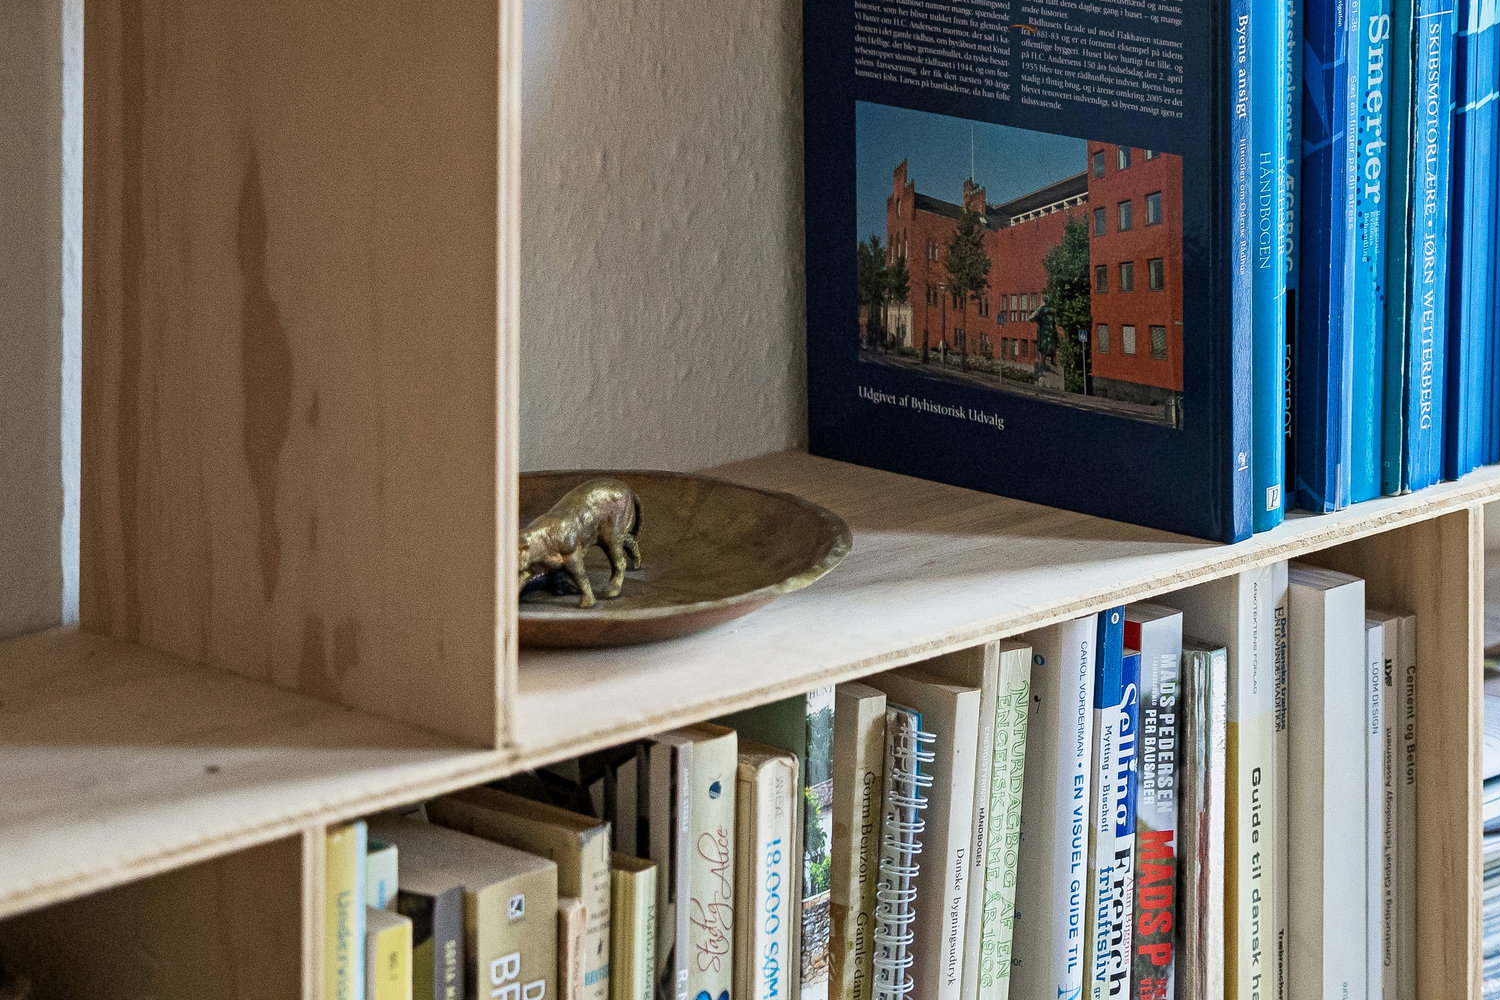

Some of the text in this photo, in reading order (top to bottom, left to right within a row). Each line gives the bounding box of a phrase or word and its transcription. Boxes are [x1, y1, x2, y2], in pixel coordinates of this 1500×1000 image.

[1236, 14, 1249, 63] Byens
[1350, 0, 1359, 32] 61.36
[1236, 68, 1248, 120] ansigt
[1349, 75, 1357, 99] Sæt
[1364, 13, 1390, 203] Smerter
[1346, 157, 1357, 172] på
[1347, 119, 1357, 154] finger
[1240, 184, 1245, 198] om
[1258, 152, 1275, 270] HÅNDBOGEN
[1348, 175, 1357, 190] dit
[1239, 240, 1247, 275] Rådhus
[1418, 22, 1440, 431] SKIBSMOTORLÆRE JØRN WETTERBERG
[858, 385, 1004, 430] Udgivet af Byhistorisk Udvalg
[1080, 640, 1089, 681] CAROL
[1076, 682, 1086, 757] VORDERMAN
[1371, 661, 1379, 735] LOOM DESIGN
[1404, 665, 1416, 785] Cement og Beton
[1143, 709, 1156, 805] PER BAUSAGER
[1157, 654, 1175, 813] MADS PEDERSEN
[1384, 727, 1392, 788] Assessment
[860, 770, 877, 819] Gorm
[1073, 774, 1084, 800] EN
[1100, 725, 1113, 833] Mytting Bischoff
[1251, 767, 1261, 844] Guide
[858, 822, 873, 884] Benzon
[979, 694, 1009, 989] ENGELSK DAME ÅR 1906
[995, 680, 1030, 979] NATURDAGBOG AF EN
[1070, 805, 1083, 874] VISUEL
[1109, 683, 1137, 998] Selling French
[1384, 790, 1393, 852] Technology
[690, 825, 734, 973] Stadig Alice
[765, 837, 782, 936] 18.000
[1138, 829, 1175, 936] MADS
[1252, 852, 1261, 880] til
[1384, 853, 1392, 889] Global
[853, 911, 869, 966] Gamle
[947, 848, 966, 987] Danske bygningsudtryk
[1068, 879, 1081, 940] GUIDE
[1095, 866, 1115, 982] friluftsliv
[1123, 877, 1134, 965] Alan Biggins
[1252, 888, 1262, 967] dansk
[1384, 899, 1393, 967] Constructing
[1068, 944, 1079, 974] TIL
